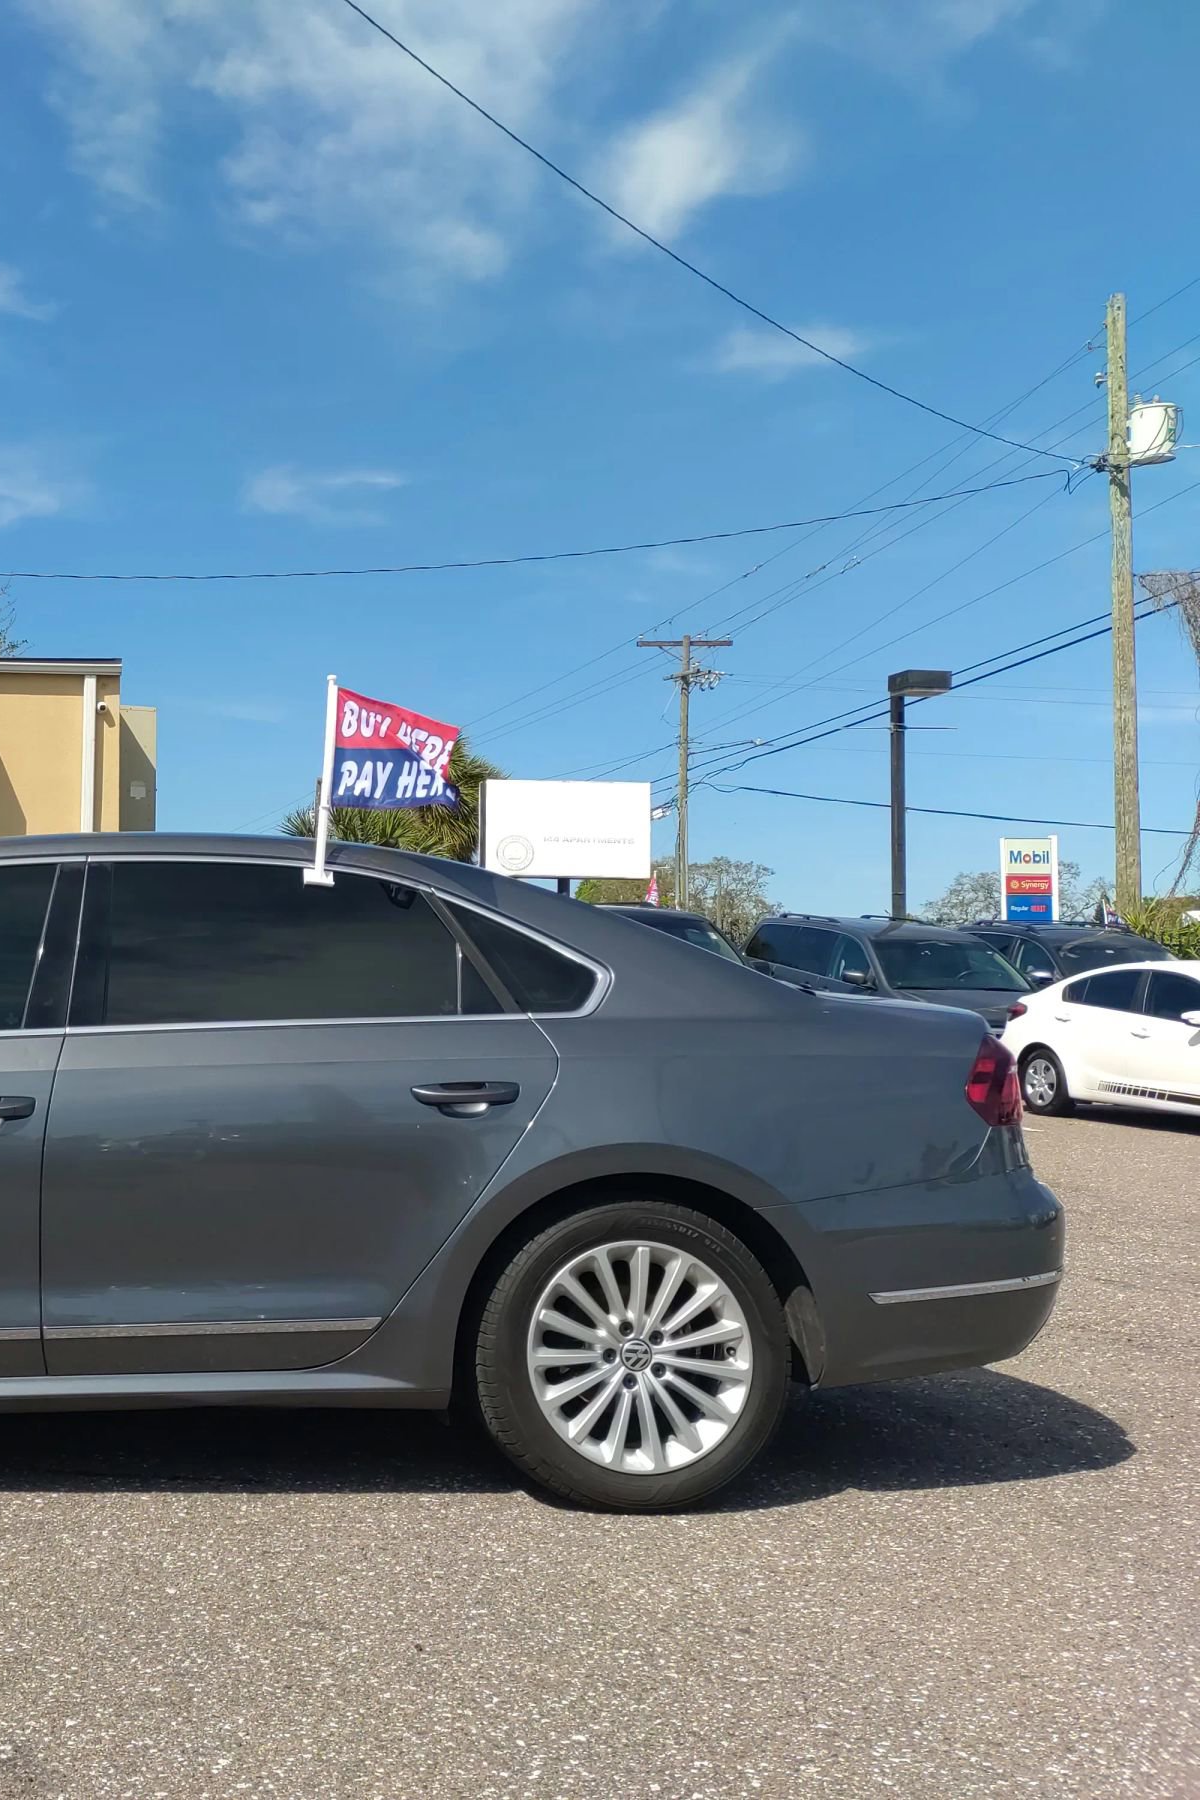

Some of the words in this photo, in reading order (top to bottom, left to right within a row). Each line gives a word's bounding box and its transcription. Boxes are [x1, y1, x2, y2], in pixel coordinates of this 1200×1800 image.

[341, 700, 392, 738] BUY
[338, 760, 394, 799] PAY
[396, 760, 456, 801] HER
[1009, 850, 1050, 864] Mobil
[1021, 880, 1049, 890] Synergy
